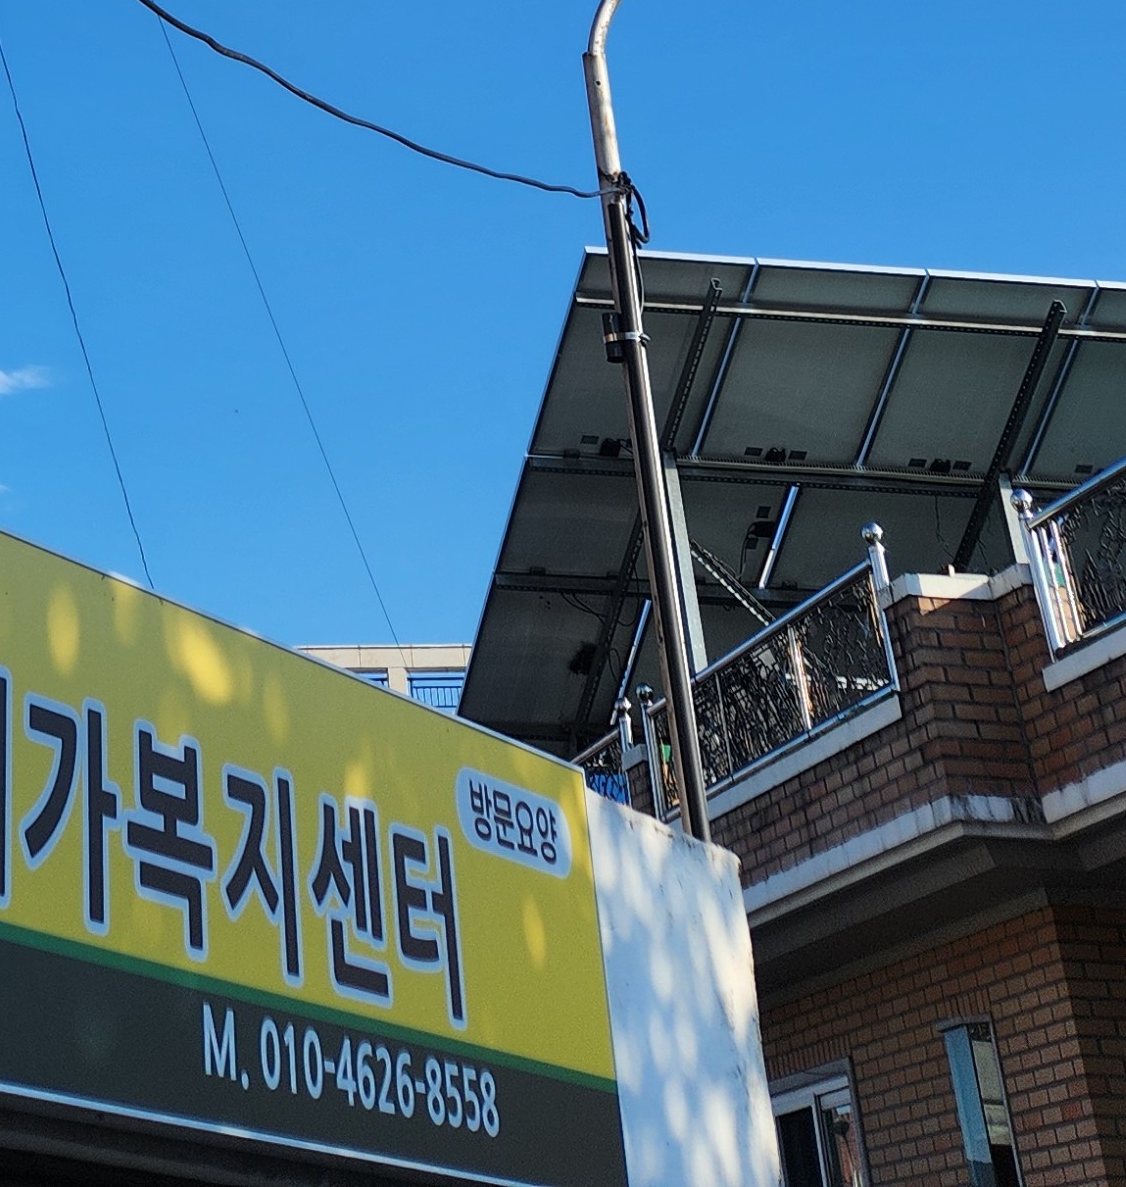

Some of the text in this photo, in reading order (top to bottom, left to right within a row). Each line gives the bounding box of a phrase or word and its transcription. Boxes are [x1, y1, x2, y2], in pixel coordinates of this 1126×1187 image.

[469, 779, 558, 864] 방문요양
[203, 1001, 500, 1138] M. 010-4626-8558
